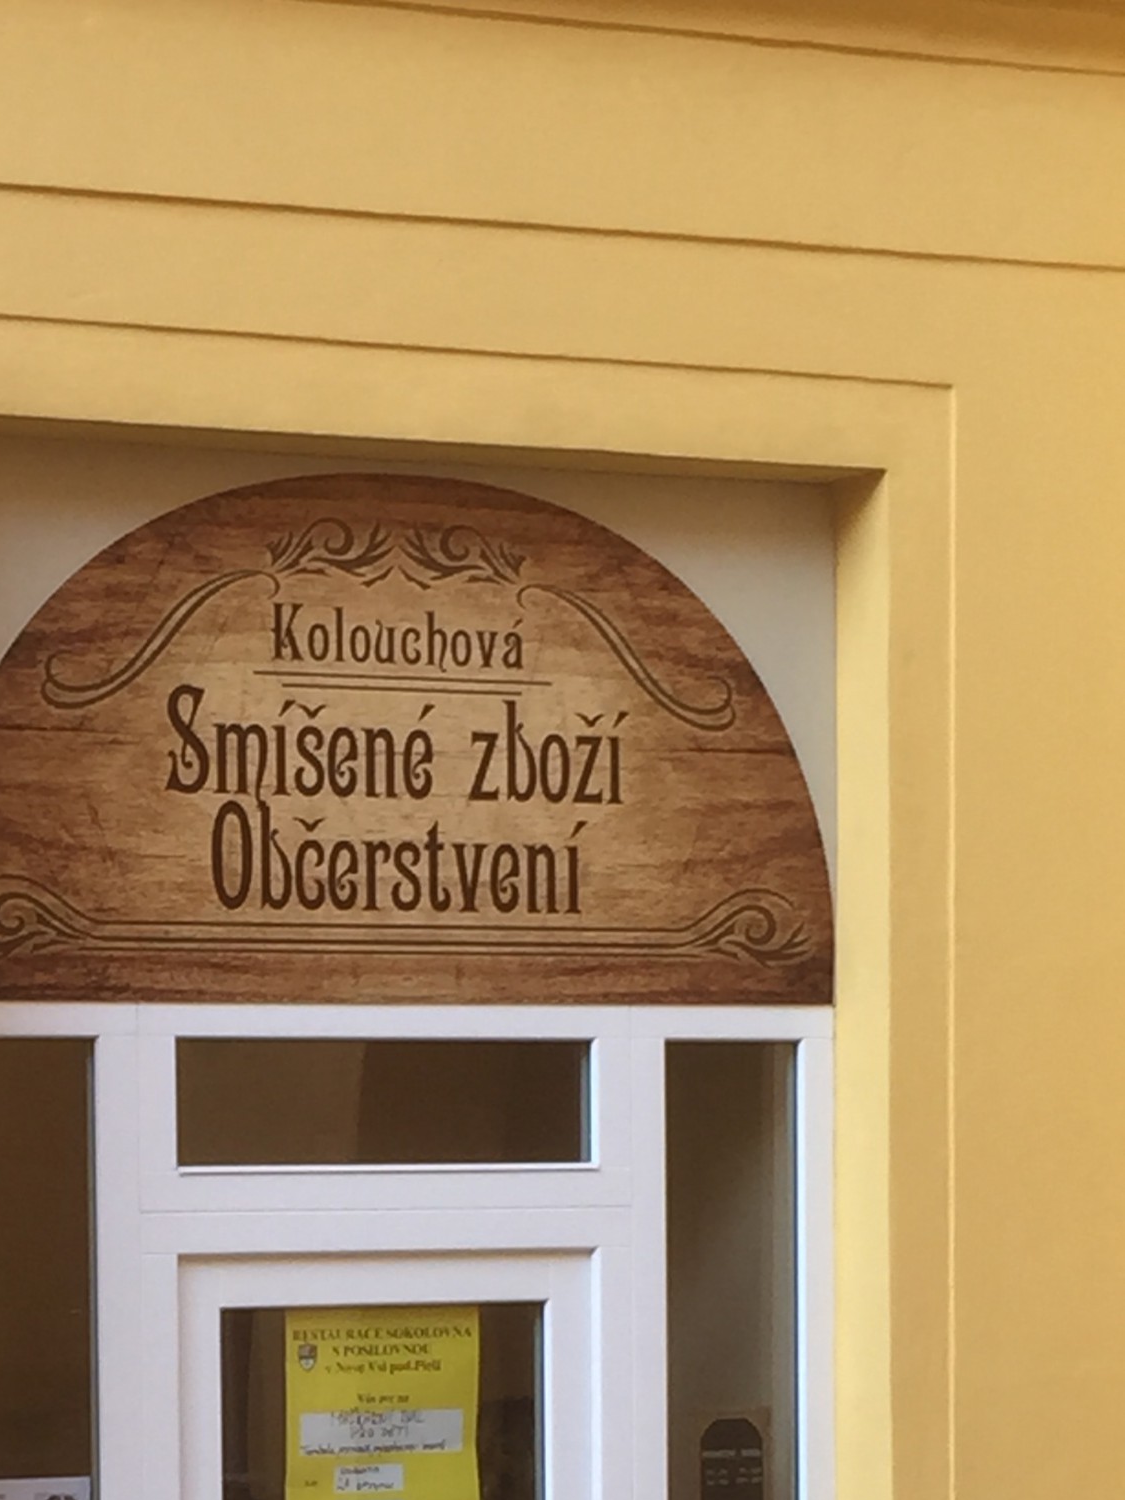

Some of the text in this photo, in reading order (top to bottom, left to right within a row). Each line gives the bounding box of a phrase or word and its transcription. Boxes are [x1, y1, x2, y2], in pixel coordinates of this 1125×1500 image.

[271, 601, 524, 673] Kolouchová
[165, 684, 630, 805] Smíšené zboží
[211, 800, 588, 914] Občerstvení
